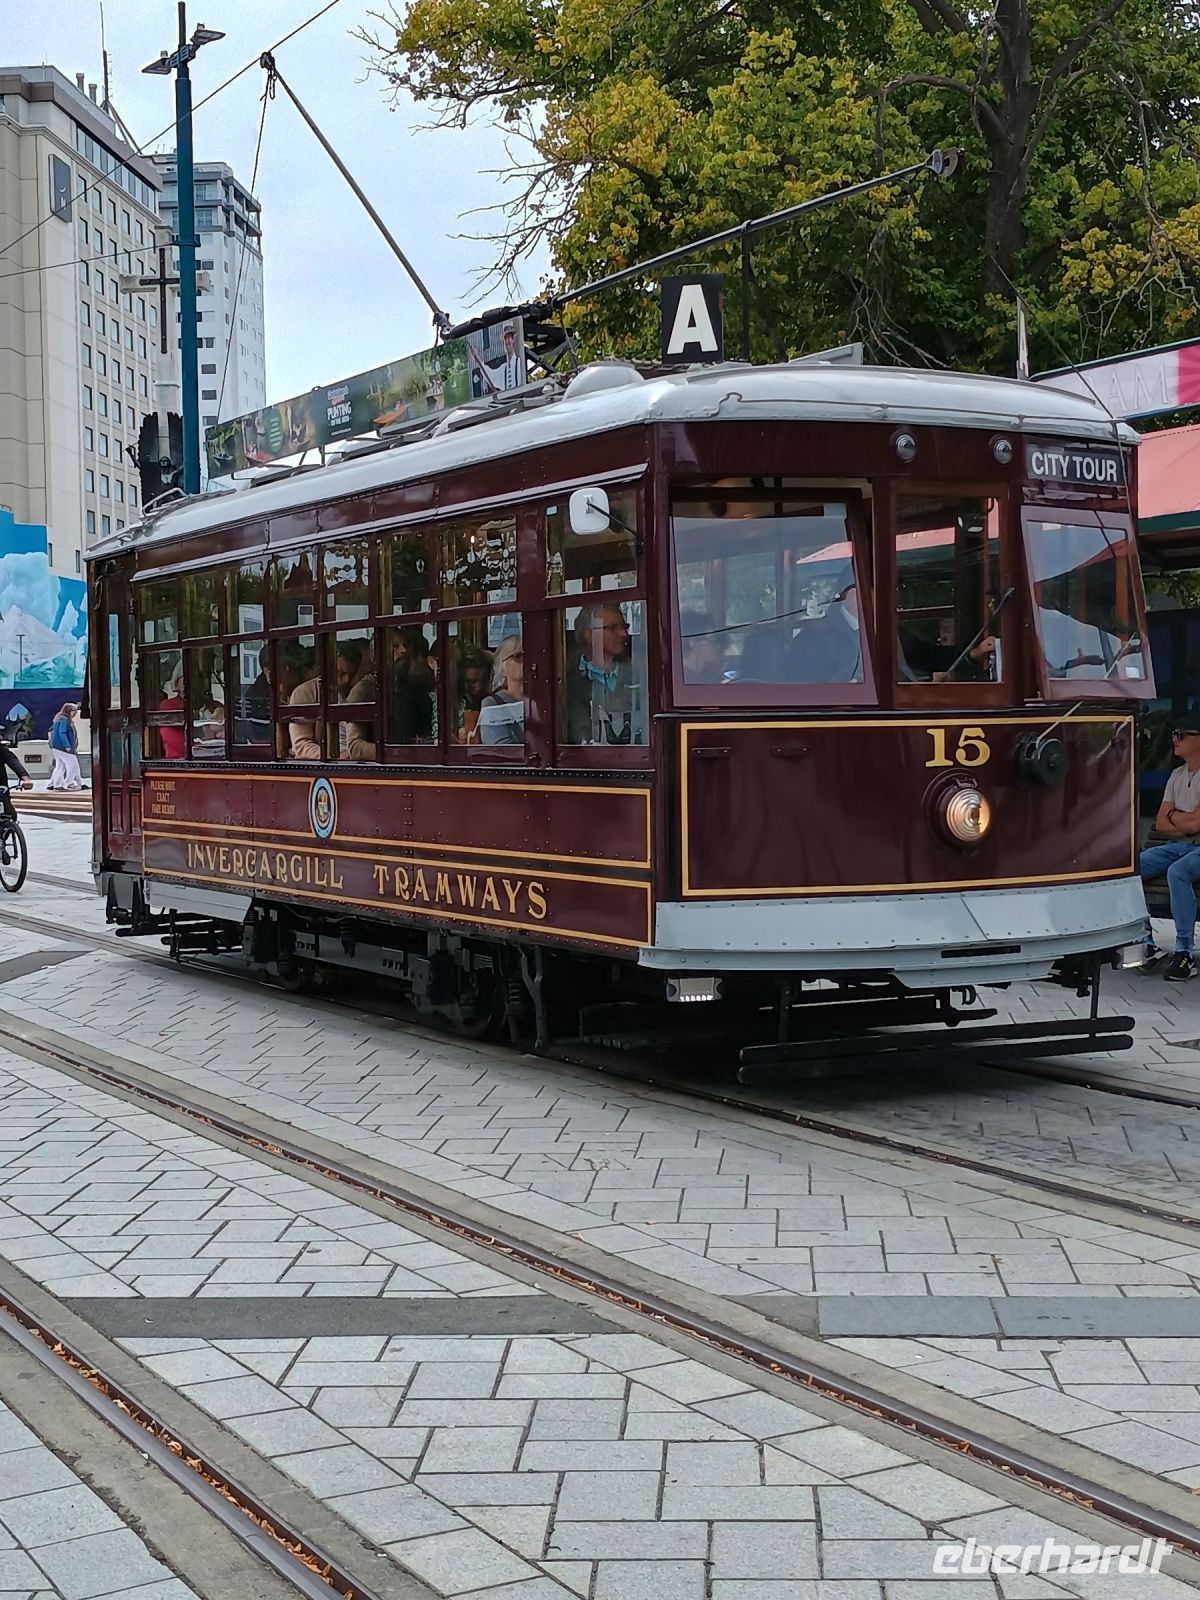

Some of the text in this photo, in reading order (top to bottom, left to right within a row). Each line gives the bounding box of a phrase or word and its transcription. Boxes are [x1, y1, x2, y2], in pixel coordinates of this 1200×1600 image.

[667, 284, 719, 355] A
[1031, 451, 1117, 482] CITY TOUR
[925, 727, 991, 767] 15
[187, 843, 548, 919] INVERCARGILL TRAMWAYS
